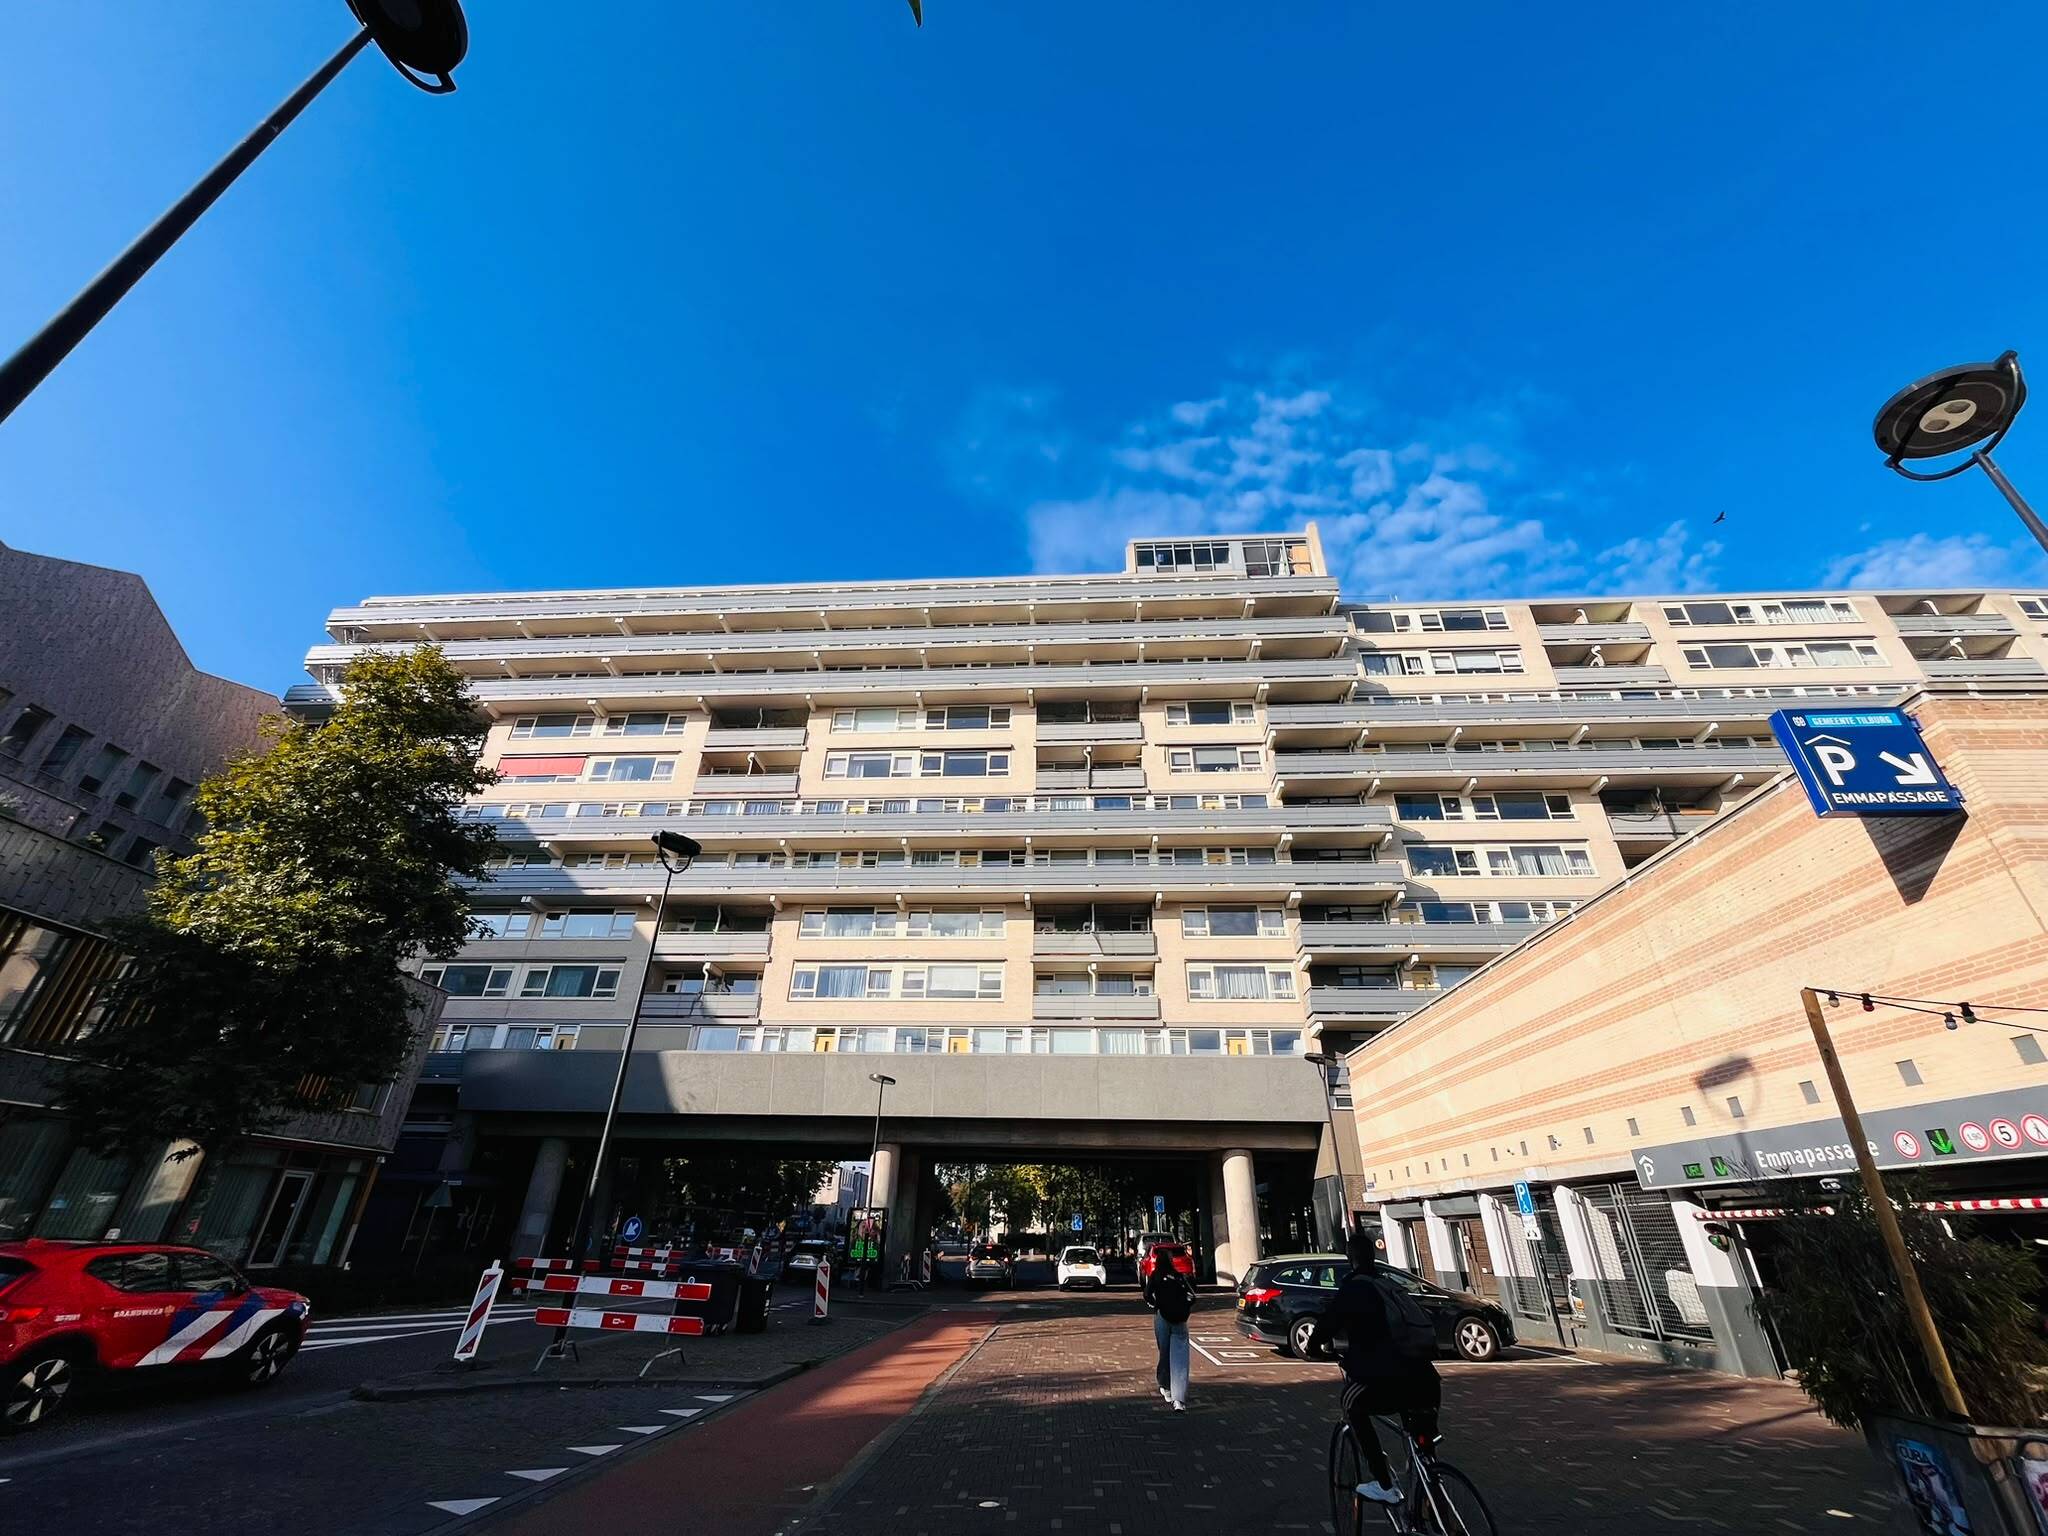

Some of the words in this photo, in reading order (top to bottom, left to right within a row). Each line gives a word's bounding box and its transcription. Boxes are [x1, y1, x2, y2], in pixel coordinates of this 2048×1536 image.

[1812, 716, 1855, 726] GEMEENTE
[1856, 715, 1892, 725] TILBURG
[1814, 745, 1856, 786] P
[1832, 791, 1949, 804] EMMAPASSAGE
[1998, 1125, 2013, 1142] 5
[1755, 1141, 1879, 1168] Emmapassae
[1643, 1162, 1655, 1184] P
